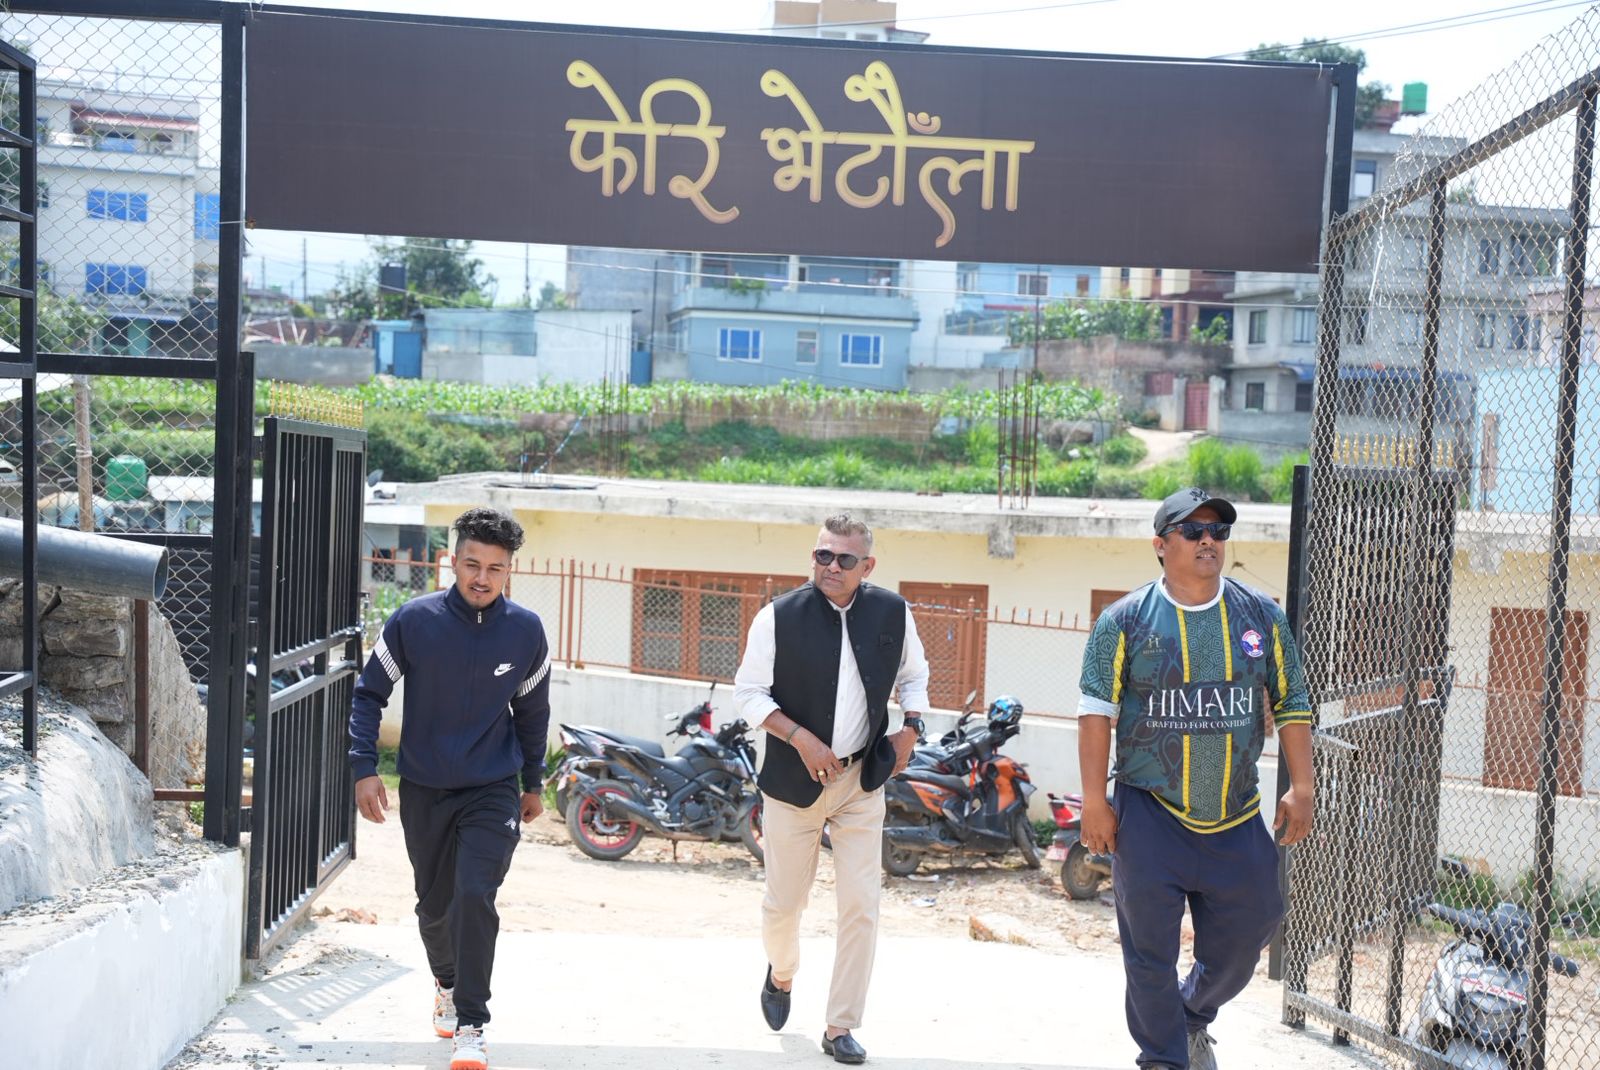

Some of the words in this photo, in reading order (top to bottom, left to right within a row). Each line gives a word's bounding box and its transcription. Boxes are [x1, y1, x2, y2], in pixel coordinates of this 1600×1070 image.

[565, 60, 740, 224] फेरि
[1146, 720, 1187, 729] CRAFTED
[1189, 721, 1208, 729] FOR
